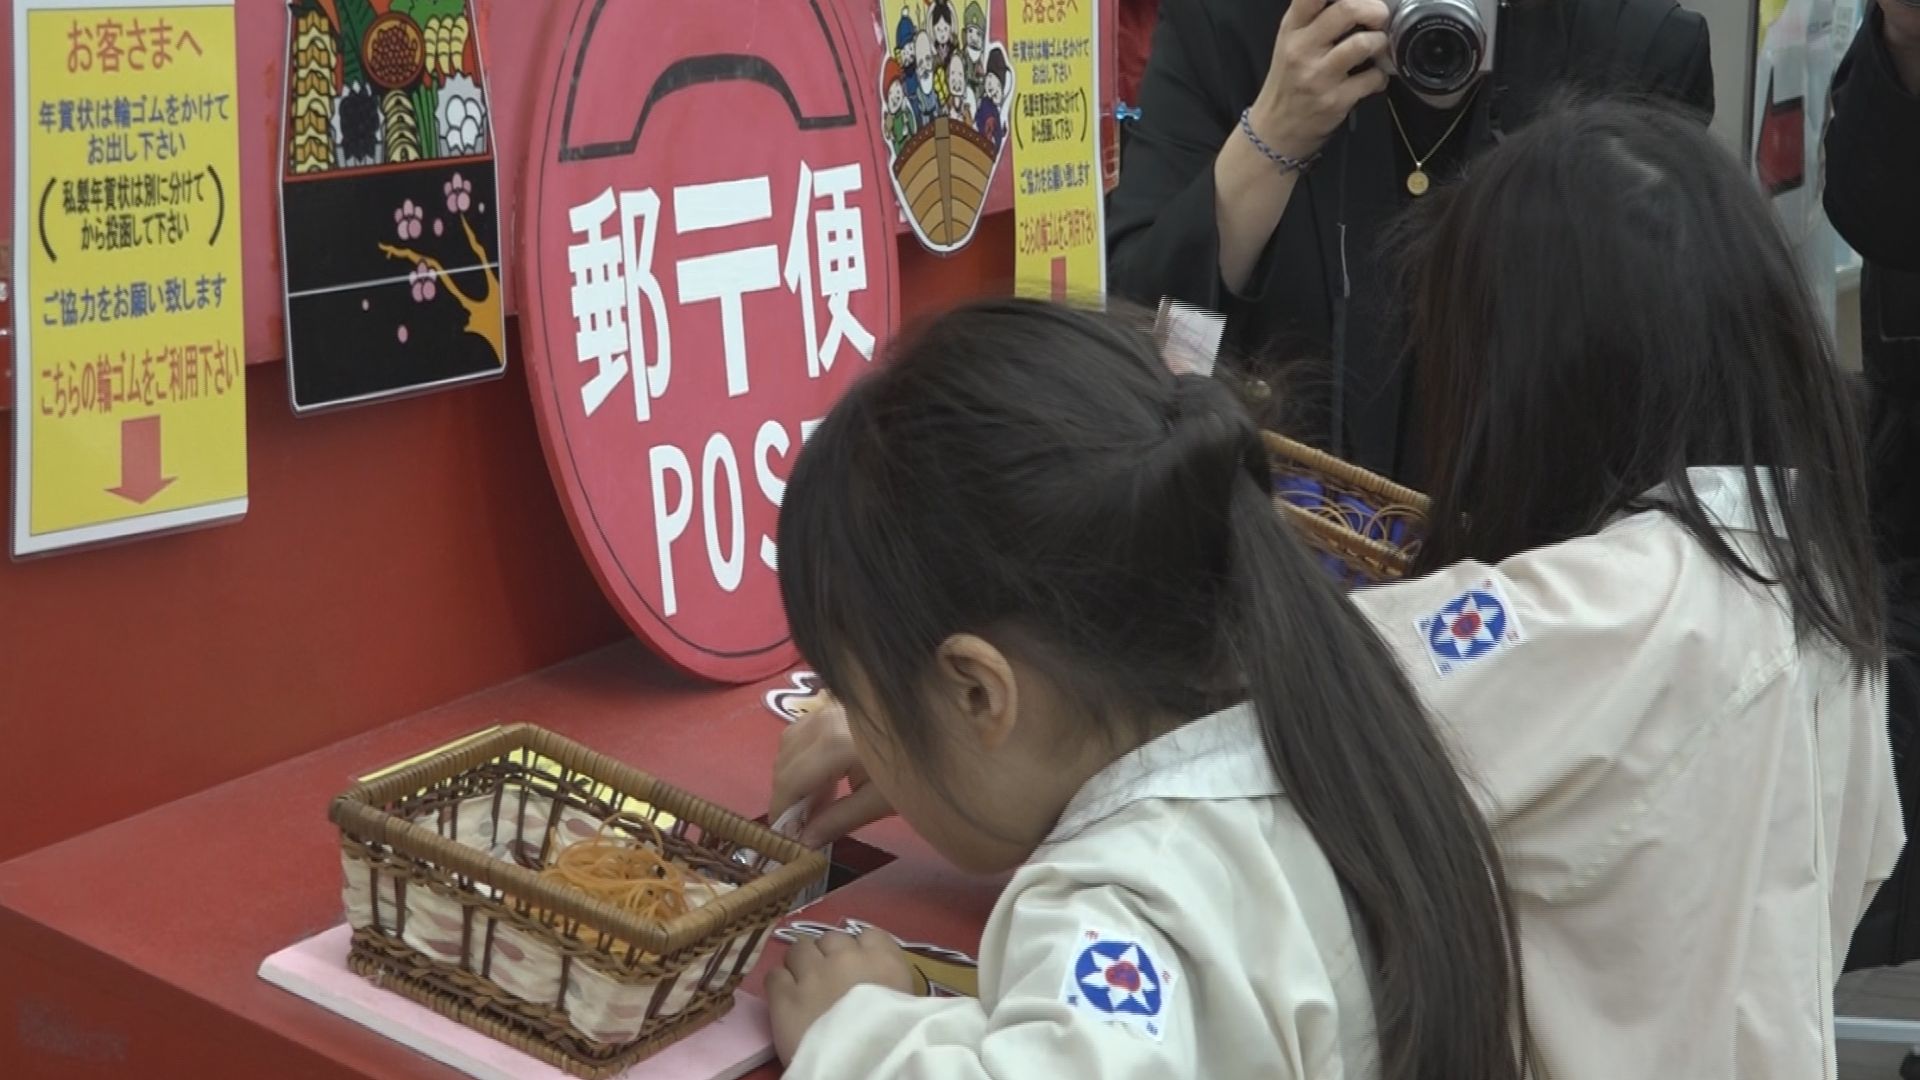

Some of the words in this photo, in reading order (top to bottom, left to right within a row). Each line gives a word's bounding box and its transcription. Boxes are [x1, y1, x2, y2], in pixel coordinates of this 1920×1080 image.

[66, 17, 203, 74] お客さまへ
[38, 93, 230, 133] 年賀状は輪ゴムをかけて
[87, 129, 186, 165] お出し下さい
[43, 273, 227, 327] ご協力をお願い致します
[41, 339, 240, 418] こちらの輪ゴムをご利用下さい
[649, 418, 828, 617] POS
